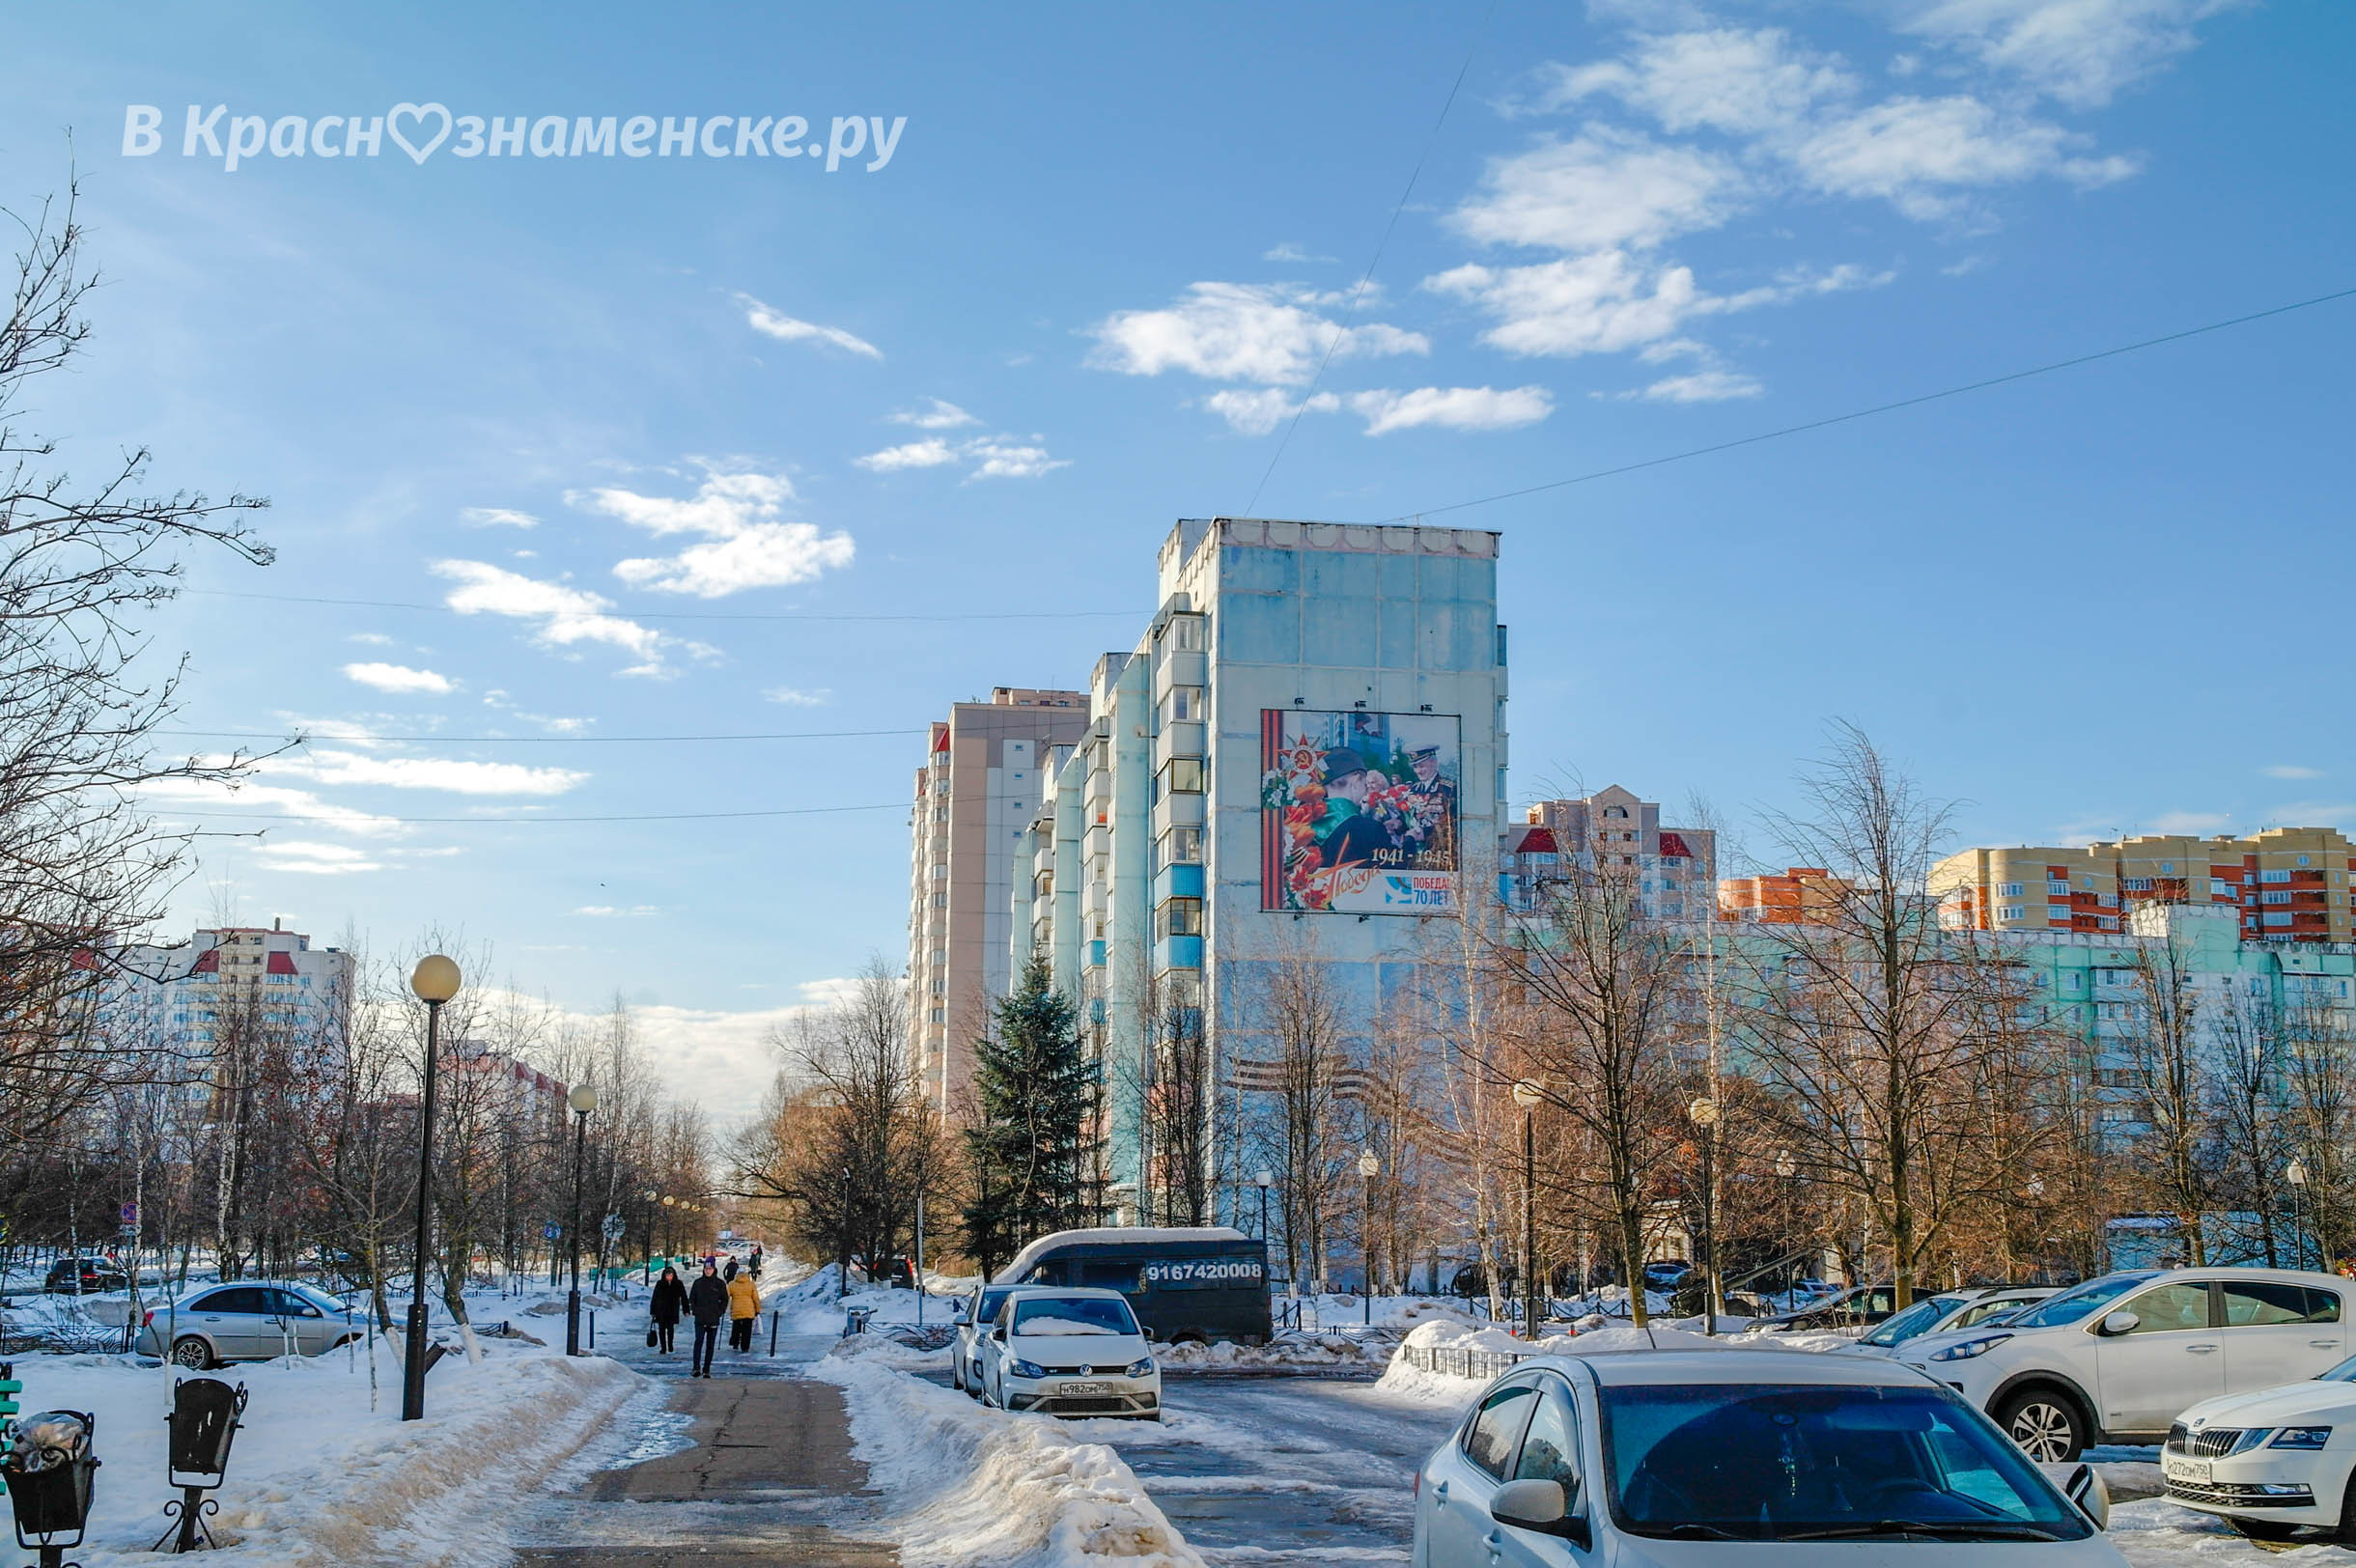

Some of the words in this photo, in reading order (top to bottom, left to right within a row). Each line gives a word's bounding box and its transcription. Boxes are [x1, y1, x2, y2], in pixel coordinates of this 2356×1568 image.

[1371, 848, 1404, 866] 1941
[1416, 849, 1449, 868] 1945
[1414, 889, 1428, 905] 70
[1429, 889, 1450, 906] ЛЕТ
[1148, 1263, 1262, 1280] 9167420008
